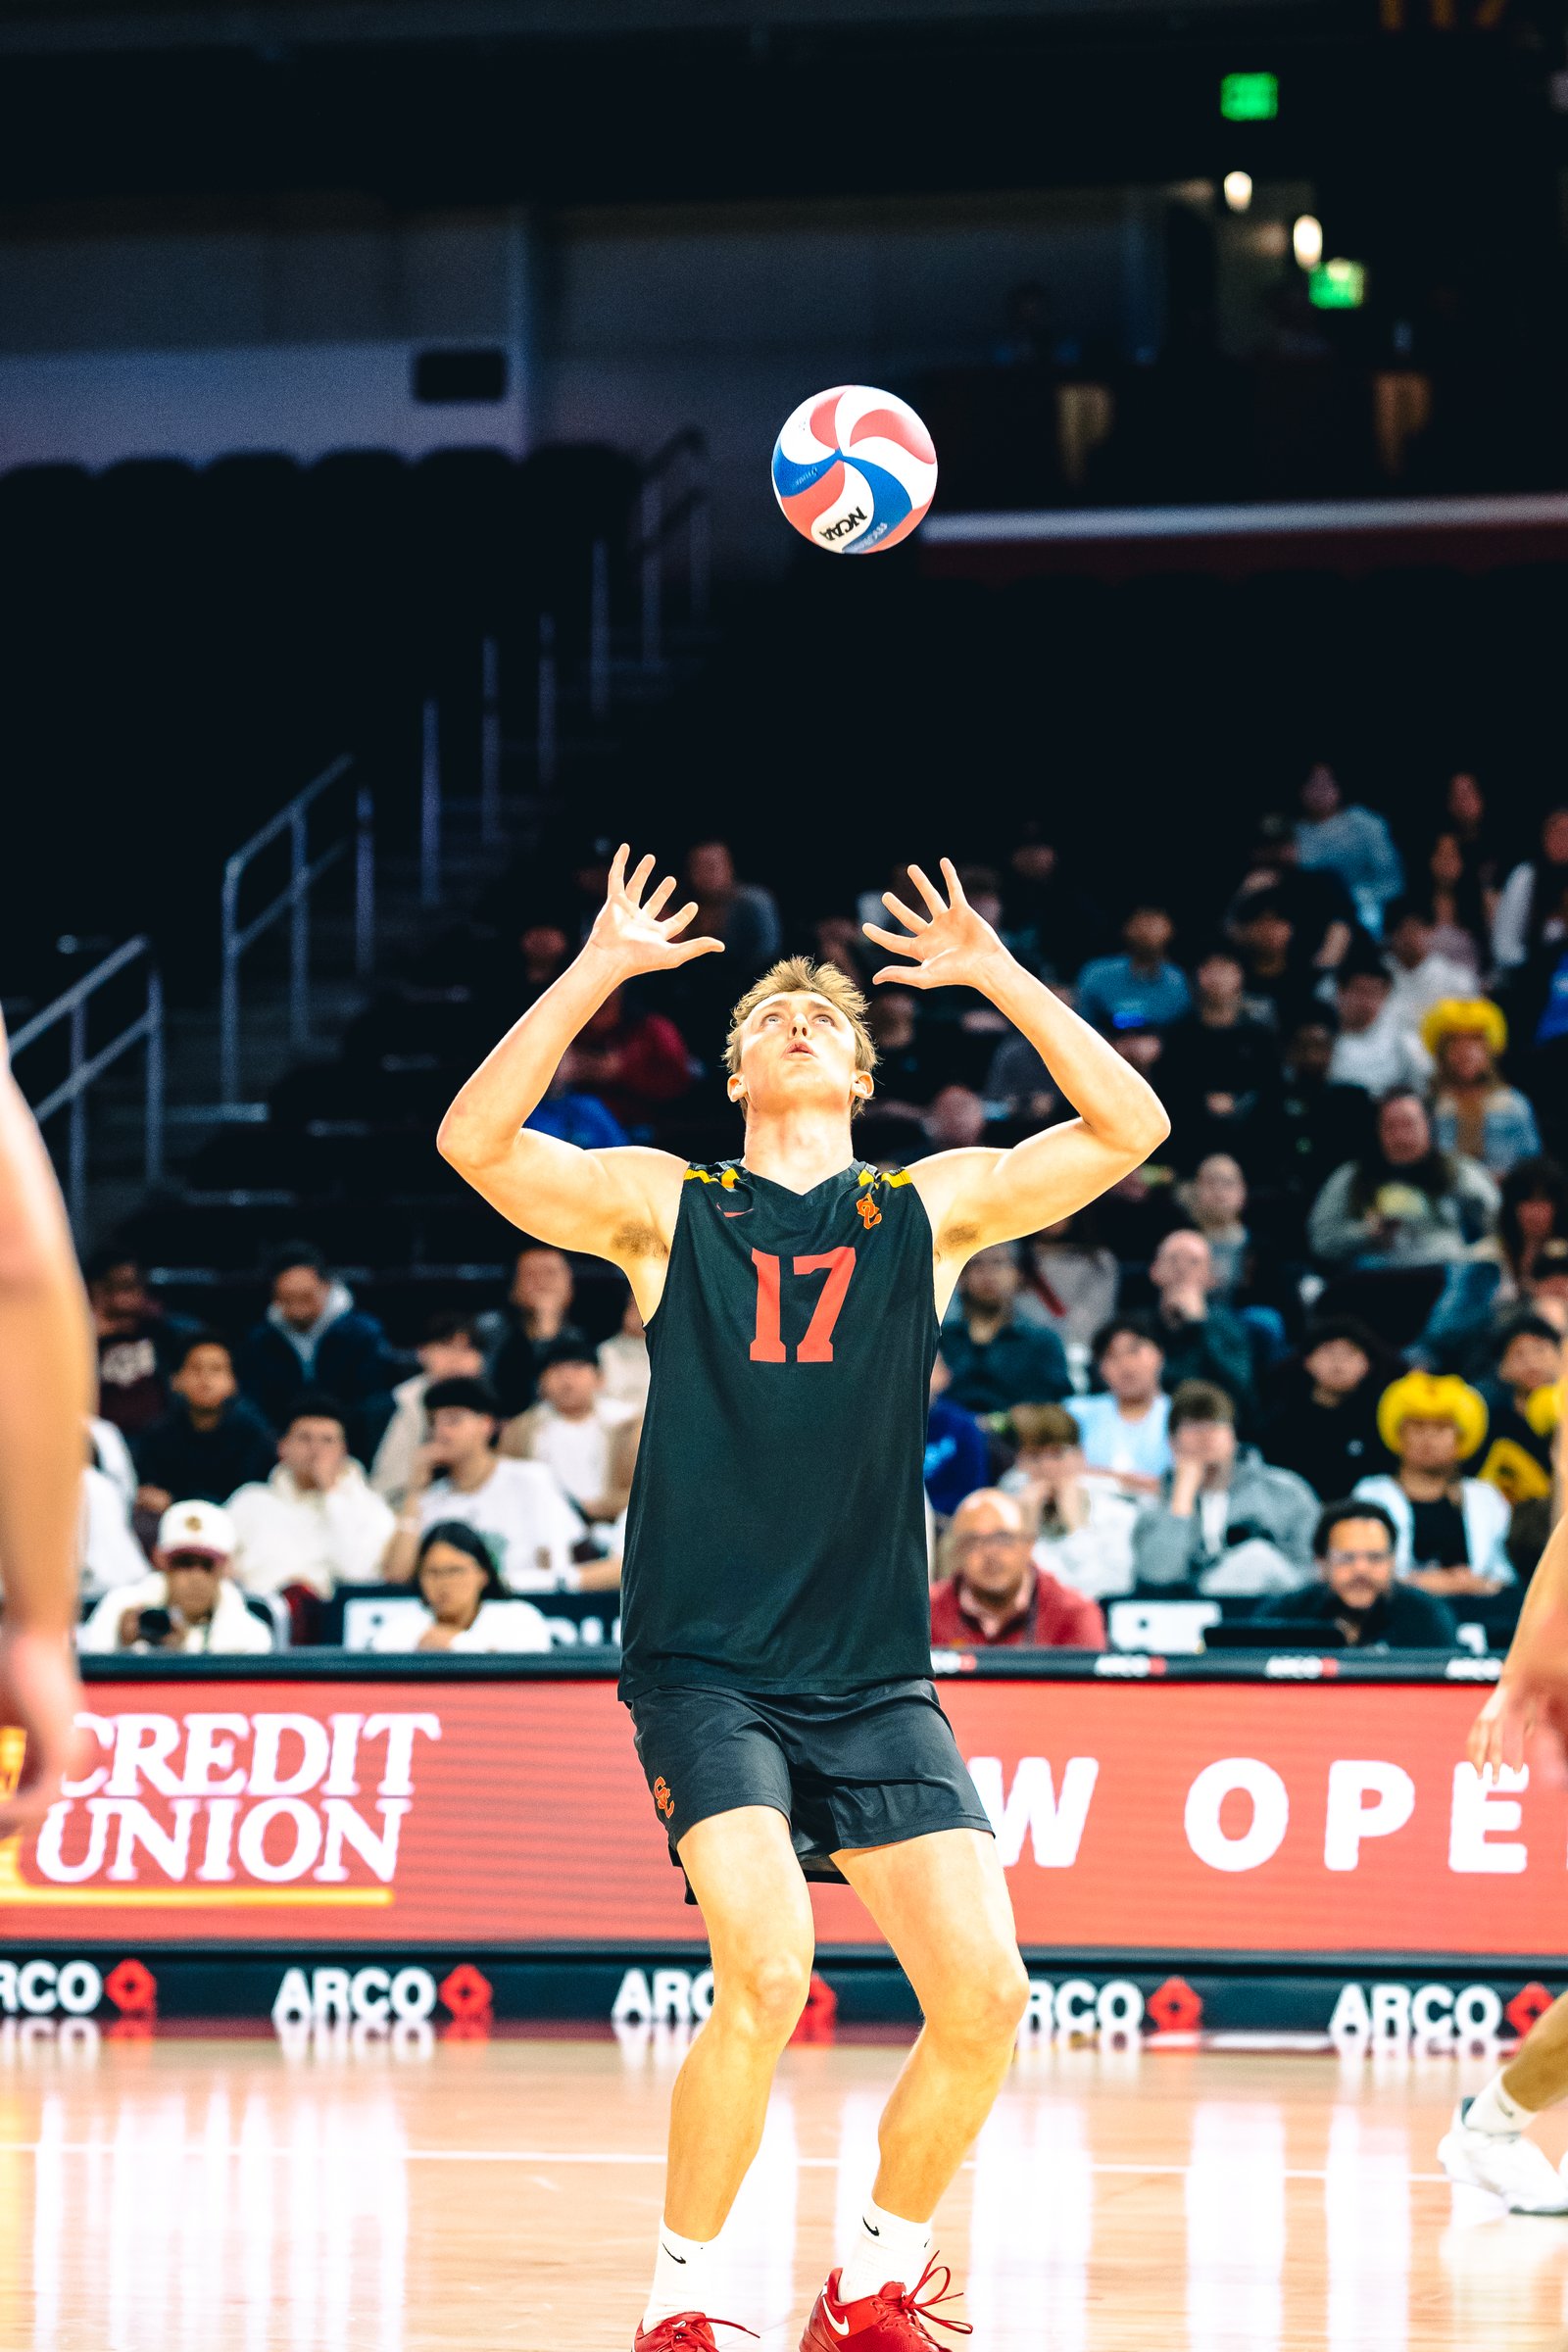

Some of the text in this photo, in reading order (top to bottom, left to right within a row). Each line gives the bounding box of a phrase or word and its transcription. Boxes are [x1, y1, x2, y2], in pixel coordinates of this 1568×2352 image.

[819, 506, 867, 541] NCAA
[749, 1246, 857, 1363] 17
[36, 1797, 411, 1883] UNION
[1184, 1757, 1568, 1873] OPE
[272, 1966, 437, 2020] ARCO
[612, 1968, 714, 2020] ARC
[1019, 1979, 1145, 2031] RCO
[1329, 1984, 1503, 2035] ARCO
